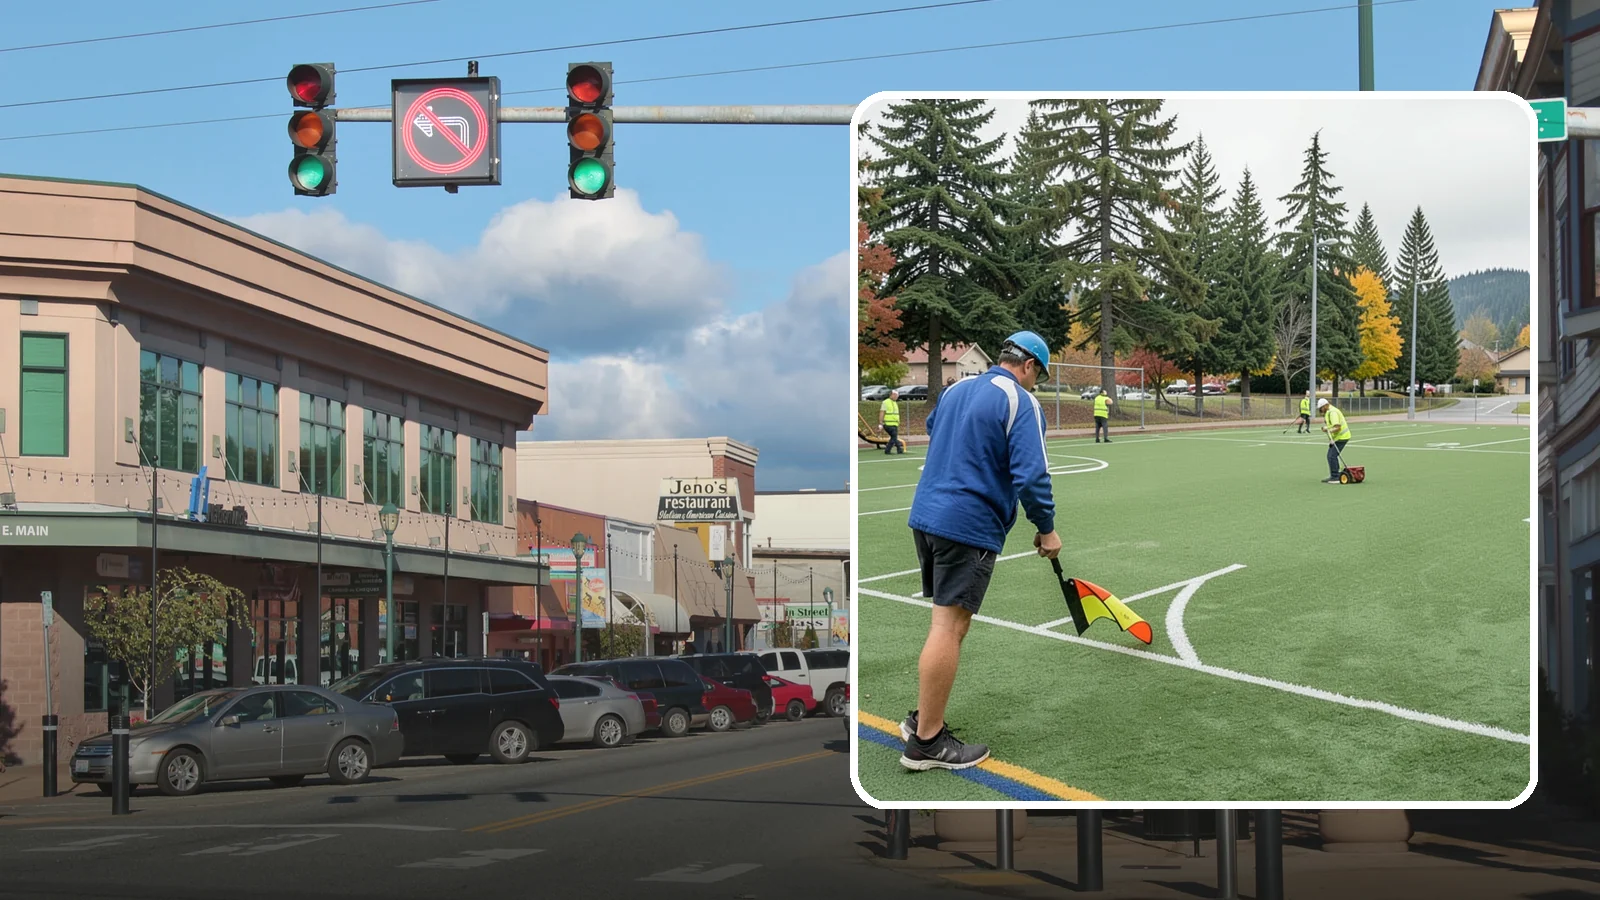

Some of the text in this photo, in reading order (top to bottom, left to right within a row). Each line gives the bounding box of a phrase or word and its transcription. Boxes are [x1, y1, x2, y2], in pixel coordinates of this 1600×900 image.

[670, 480, 727, 494] Jeno's
[665, 496, 731, 509] restaurant
[659, 510, 681, 519] Italian
[686, 510, 715, 519] American
[715, 510, 738, 519] Cuisine
[2, 525, 49, 536] E. MAIN
[797, 607, 828, 616] Street
